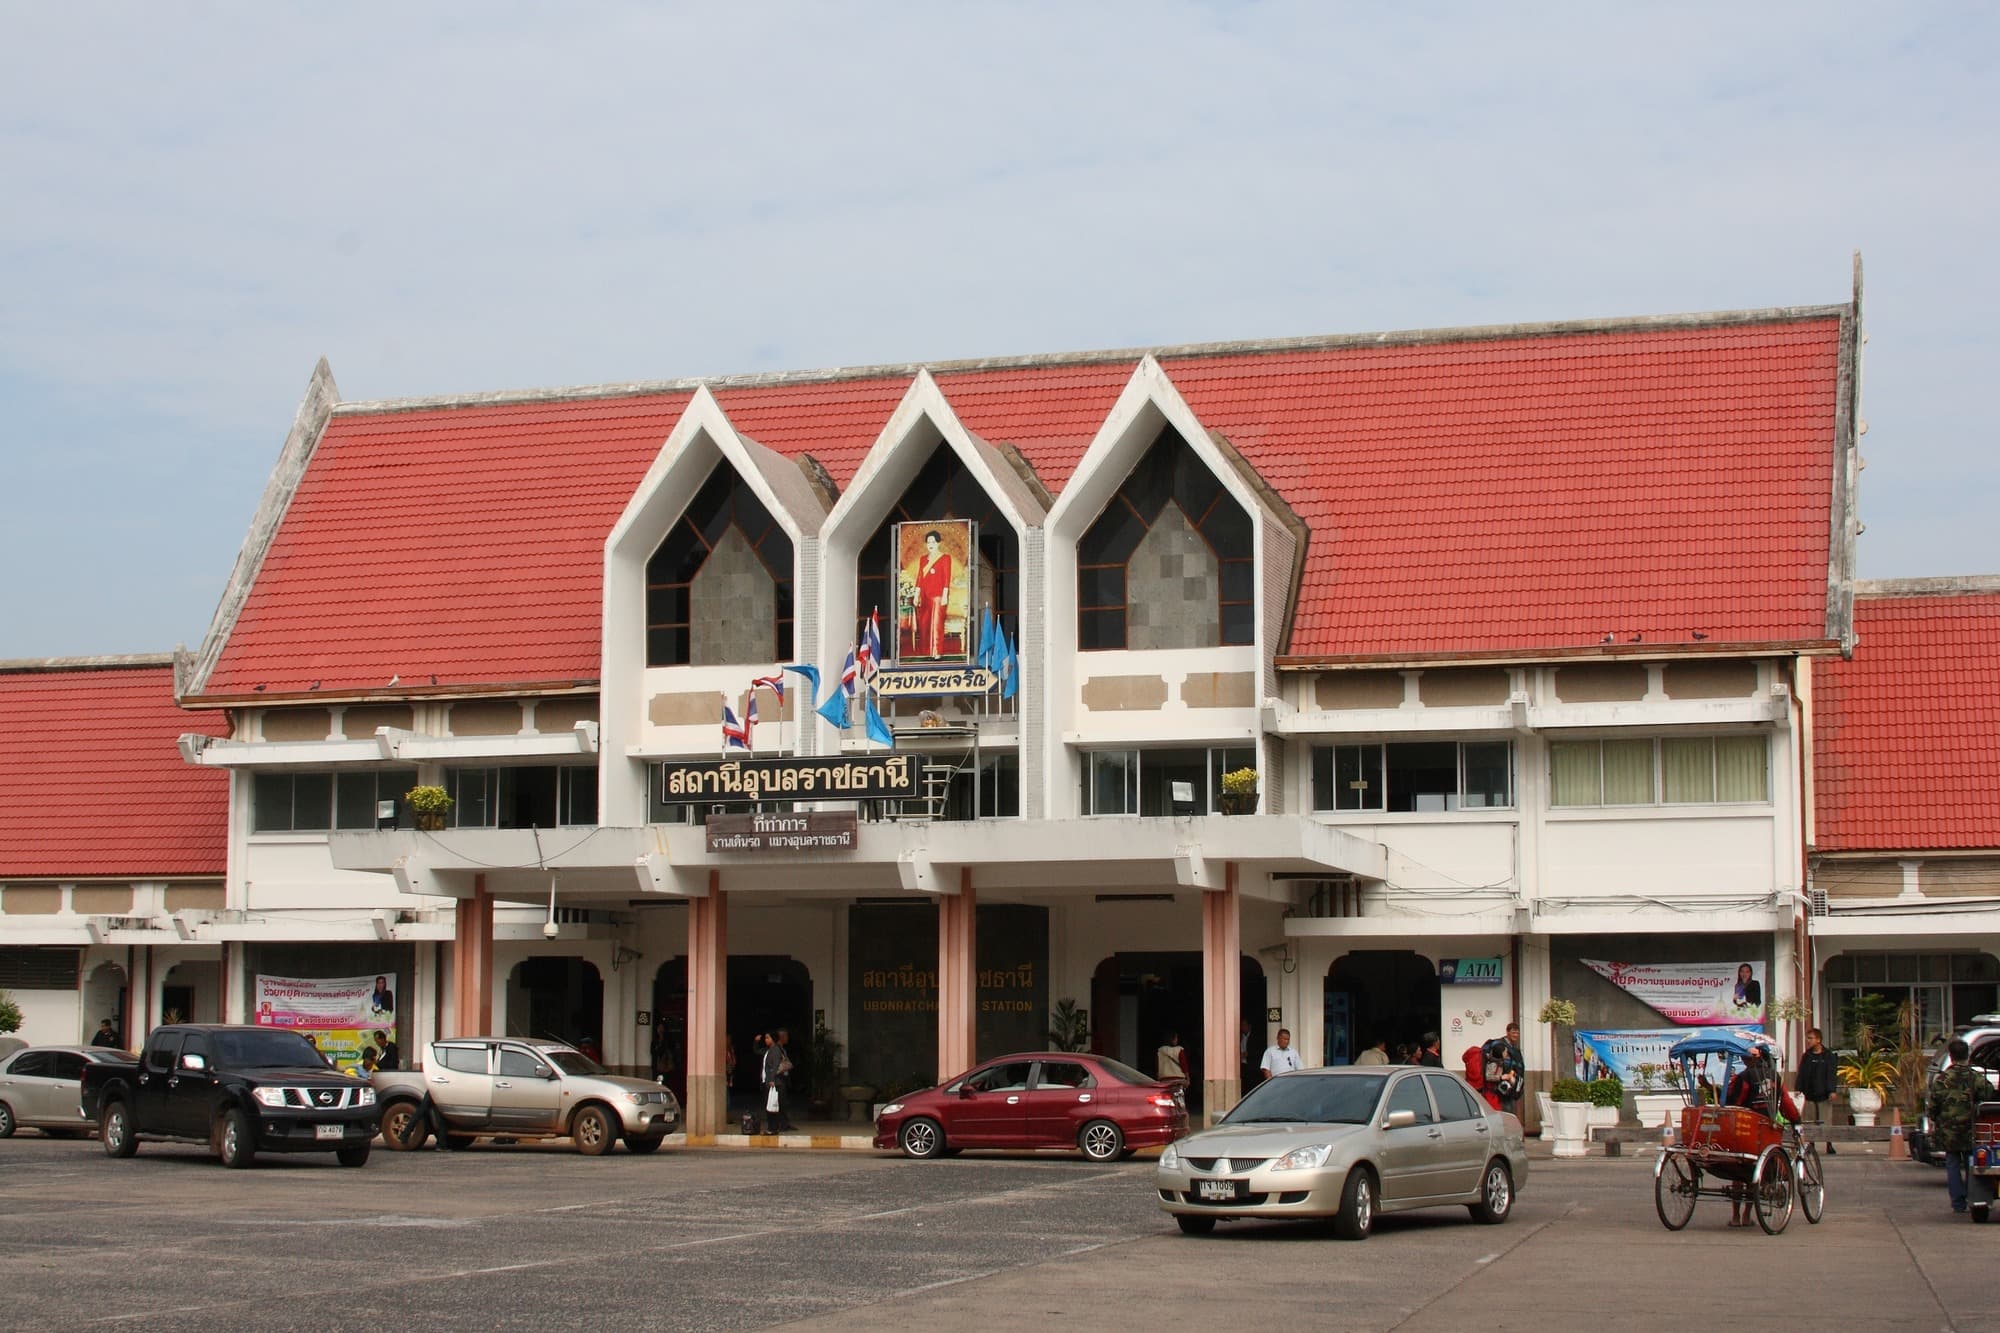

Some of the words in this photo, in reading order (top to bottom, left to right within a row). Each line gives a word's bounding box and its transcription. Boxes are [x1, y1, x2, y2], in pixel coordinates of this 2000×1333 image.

[669, 756, 909, 799] สถานีอุบลราชธานี
[753, 814, 807, 832] ที่ทำการ
[712, 834, 760, 848] งานเดินรถ
[769, 831, 850, 849] แขวงอุบลราชธานี
[1465, 963, 1496, 976] ATM
[982, 1000, 1032, 1011] STATION
